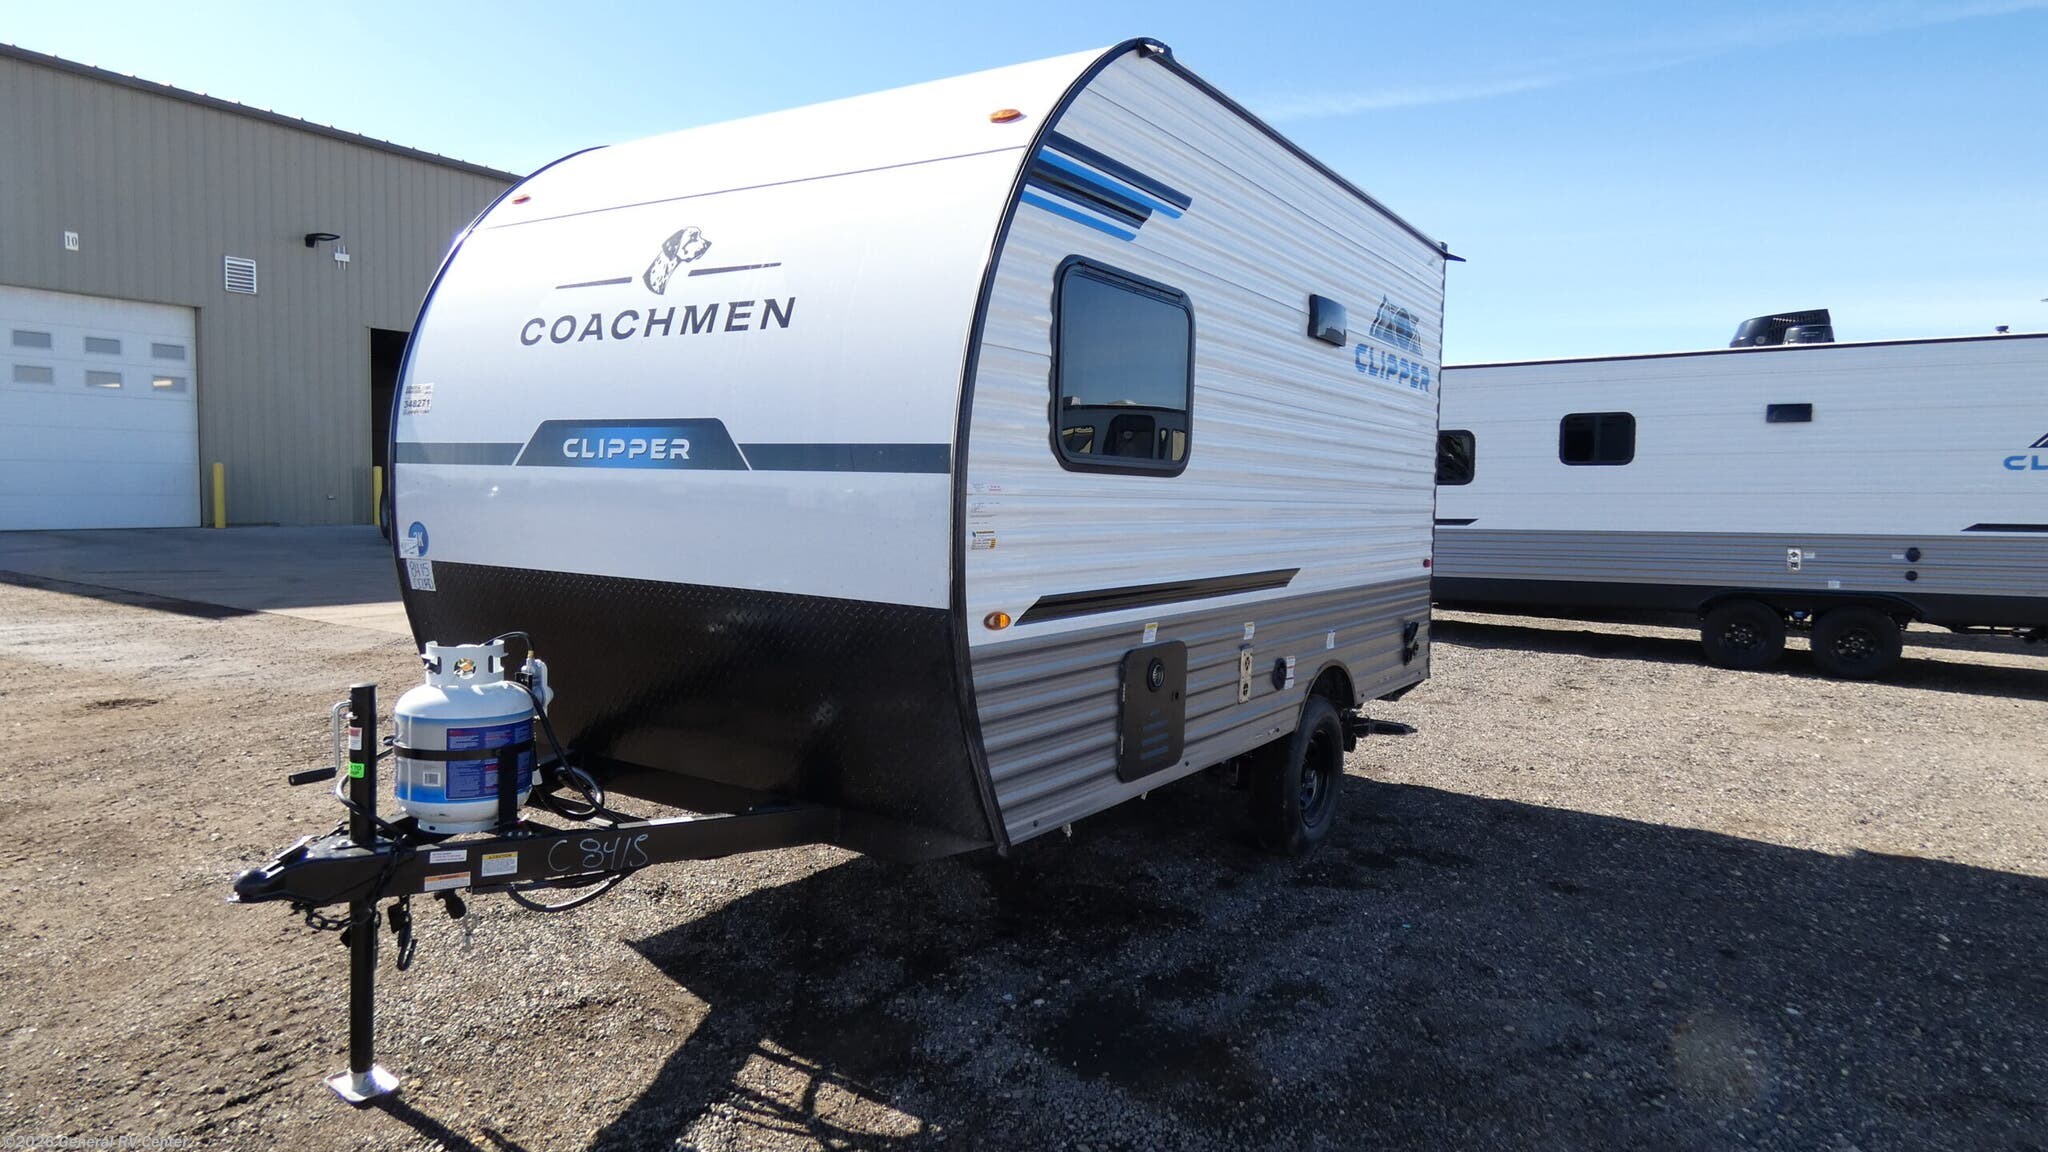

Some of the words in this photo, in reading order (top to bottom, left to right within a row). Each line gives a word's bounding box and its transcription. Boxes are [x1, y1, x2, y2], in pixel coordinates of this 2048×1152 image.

[66, 235, 78, 248] 10
[520, 297, 796, 346] COACHMEN
[1355, 343, 1430, 392] CLIPPER
[562, 438, 690, 460] CLIPPER
[548, 839, 571, 872] C
